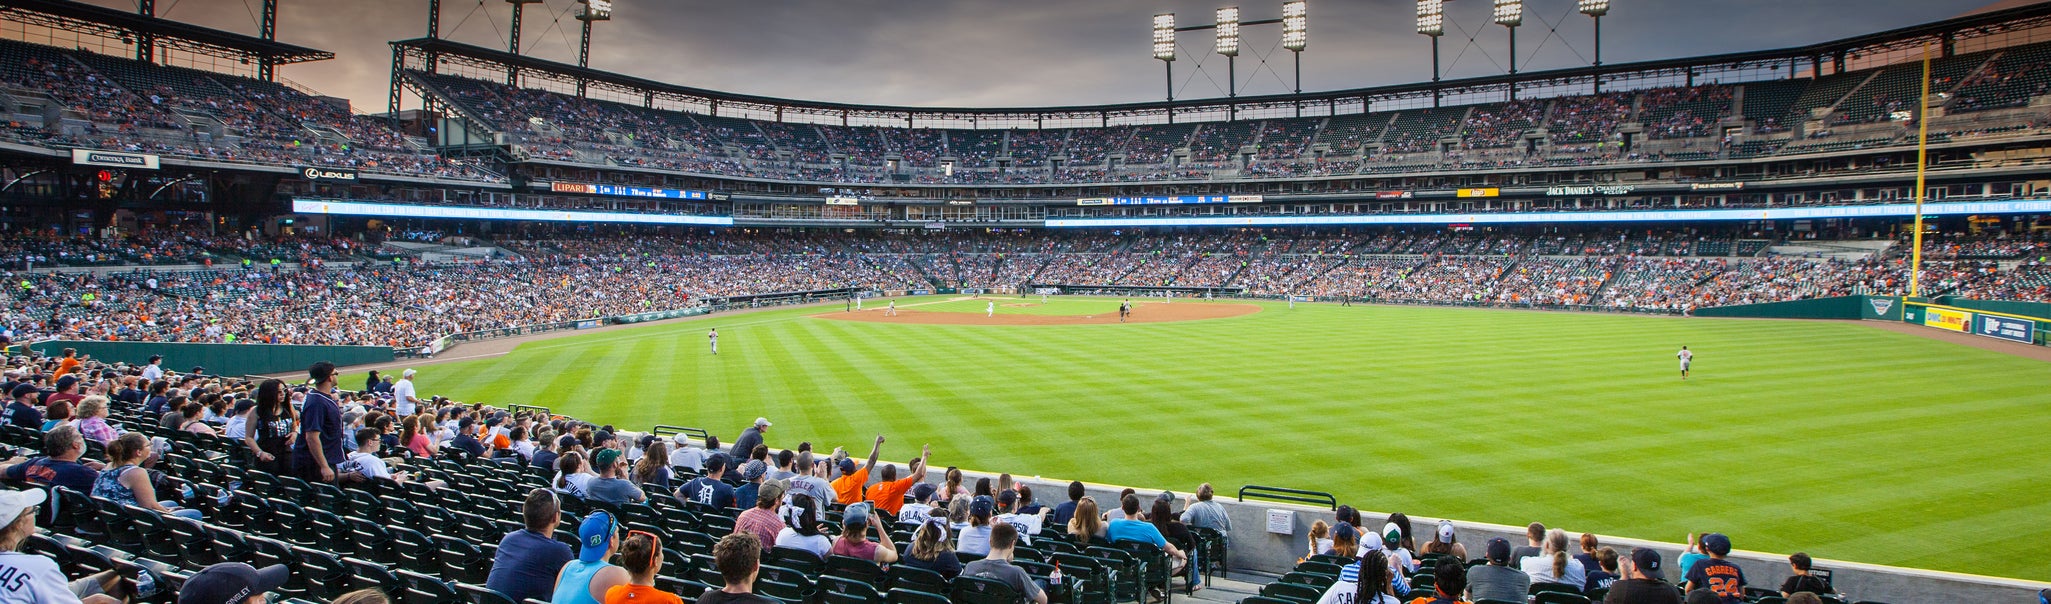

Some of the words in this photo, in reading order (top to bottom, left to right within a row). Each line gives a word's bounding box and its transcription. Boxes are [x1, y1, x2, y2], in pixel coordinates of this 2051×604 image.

[319, 171, 355, 180] LEXUS
[557, 183, 584, 192] LIPARI
[1546, 186, 1564, 196] JACK
[1565, 185, 1594, 195] DANIEL'S
[1704, 565, 1738, 577] CABRERA
